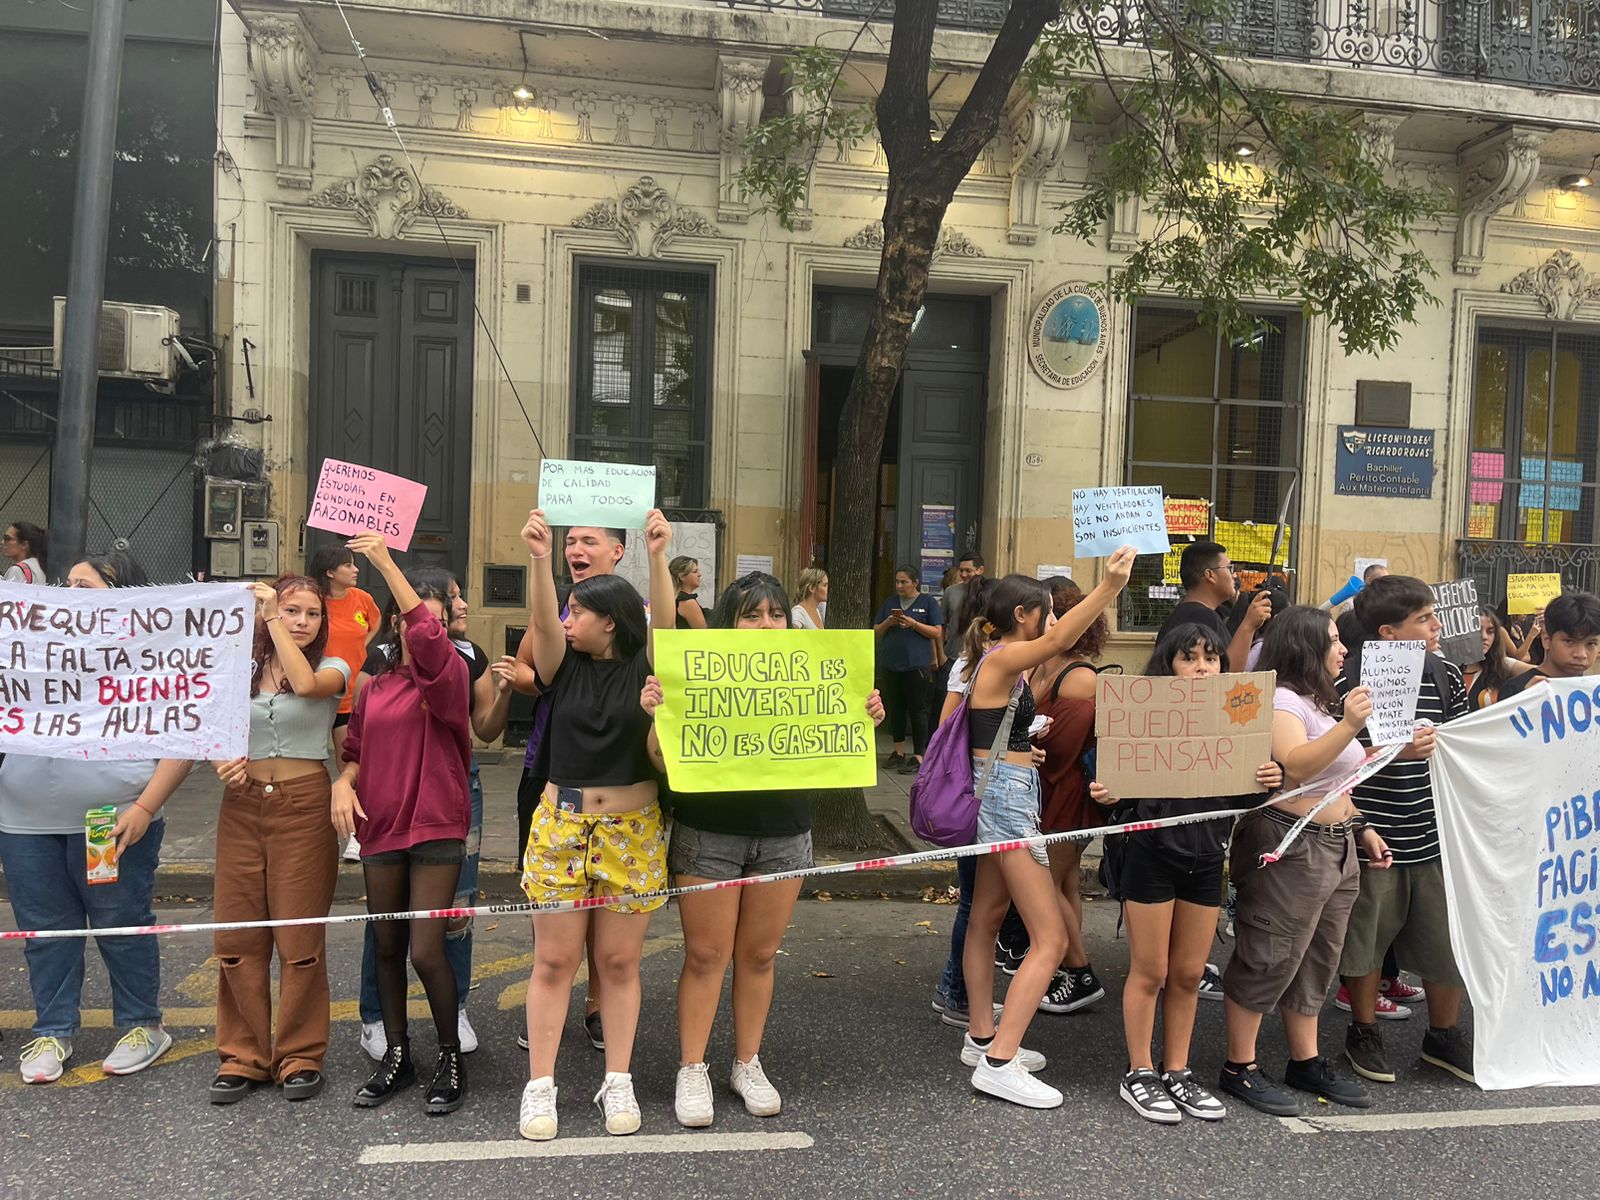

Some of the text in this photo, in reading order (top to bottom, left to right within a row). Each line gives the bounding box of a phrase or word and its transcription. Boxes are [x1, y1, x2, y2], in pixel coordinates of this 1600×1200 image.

[1054, 291, 1064, 301] DE
[1063, 286, 1073, 295] LA
[1074, 285, 1097, 299] CIUDAD
[1033, 298, 1055, 347] MUNICIPALIDAD
[1098, 305, 1108, 333] BUENOS
[1096, 334, 1106, 355] AIRES
[1035, 353, 1099, 386] SECRETARIA DE EDUCACION
[1367, 433, 1394, 443] LICEO
[1403, 435, 1411, 444] 10
[324, 461, 376, 481] QUEREMOS
[542, 462, 564, 475] POR
[1366, 463, 1403, 473] Bachiller
[542, 478, 553, 488] DE
[1349, 471, 1420, 484] Perito Contable
[1072, 490, 1086, 500] NO
[1093, 489, 1109, 500] HAY
[1340, 482, 1429, 494] Aux Materno Infantil
[316, 490, 394, 518] CONDICIONES
[380, 492, 396, 504] EN
[545, 493, 633, 506] PARA TODOS
[1073, 504, 1090, 516] HAY
[313, 502, 400, 537] RAZONABLES
[1074, 516, 1092, 528] QUE
[1096, 515, 1109, 524] NO
[1115, 511, 1140, 520] ANDAN
[1075, 532, 1096, 543] SON
[130, 607, 173, 635] NO
[184, 607, 245, 638] NOS
[1388, 641, 1426, 651] FAMILIAS
[684, 650, 847, 683] EDUCAR ES
[1362, 654, 1394, 666] Y LOS
[1362, 665, 1411, 677] ALUMNOS
[44, 678, 81, 705] EN
[97, 672, 212, 706] BUENAS
[1104, 677, 1208, 704] NO SE
[34, 712, 82, 737] LAS
[101, 703, 201, 738] AULAS
[1107, 708, 1203, 738] PUEDE
[681, 721, 868, 758] NO ES GASTAR
[1117, 737, 1234, 772] PENSAR
[1540, 965, 1574, 1007] NO
